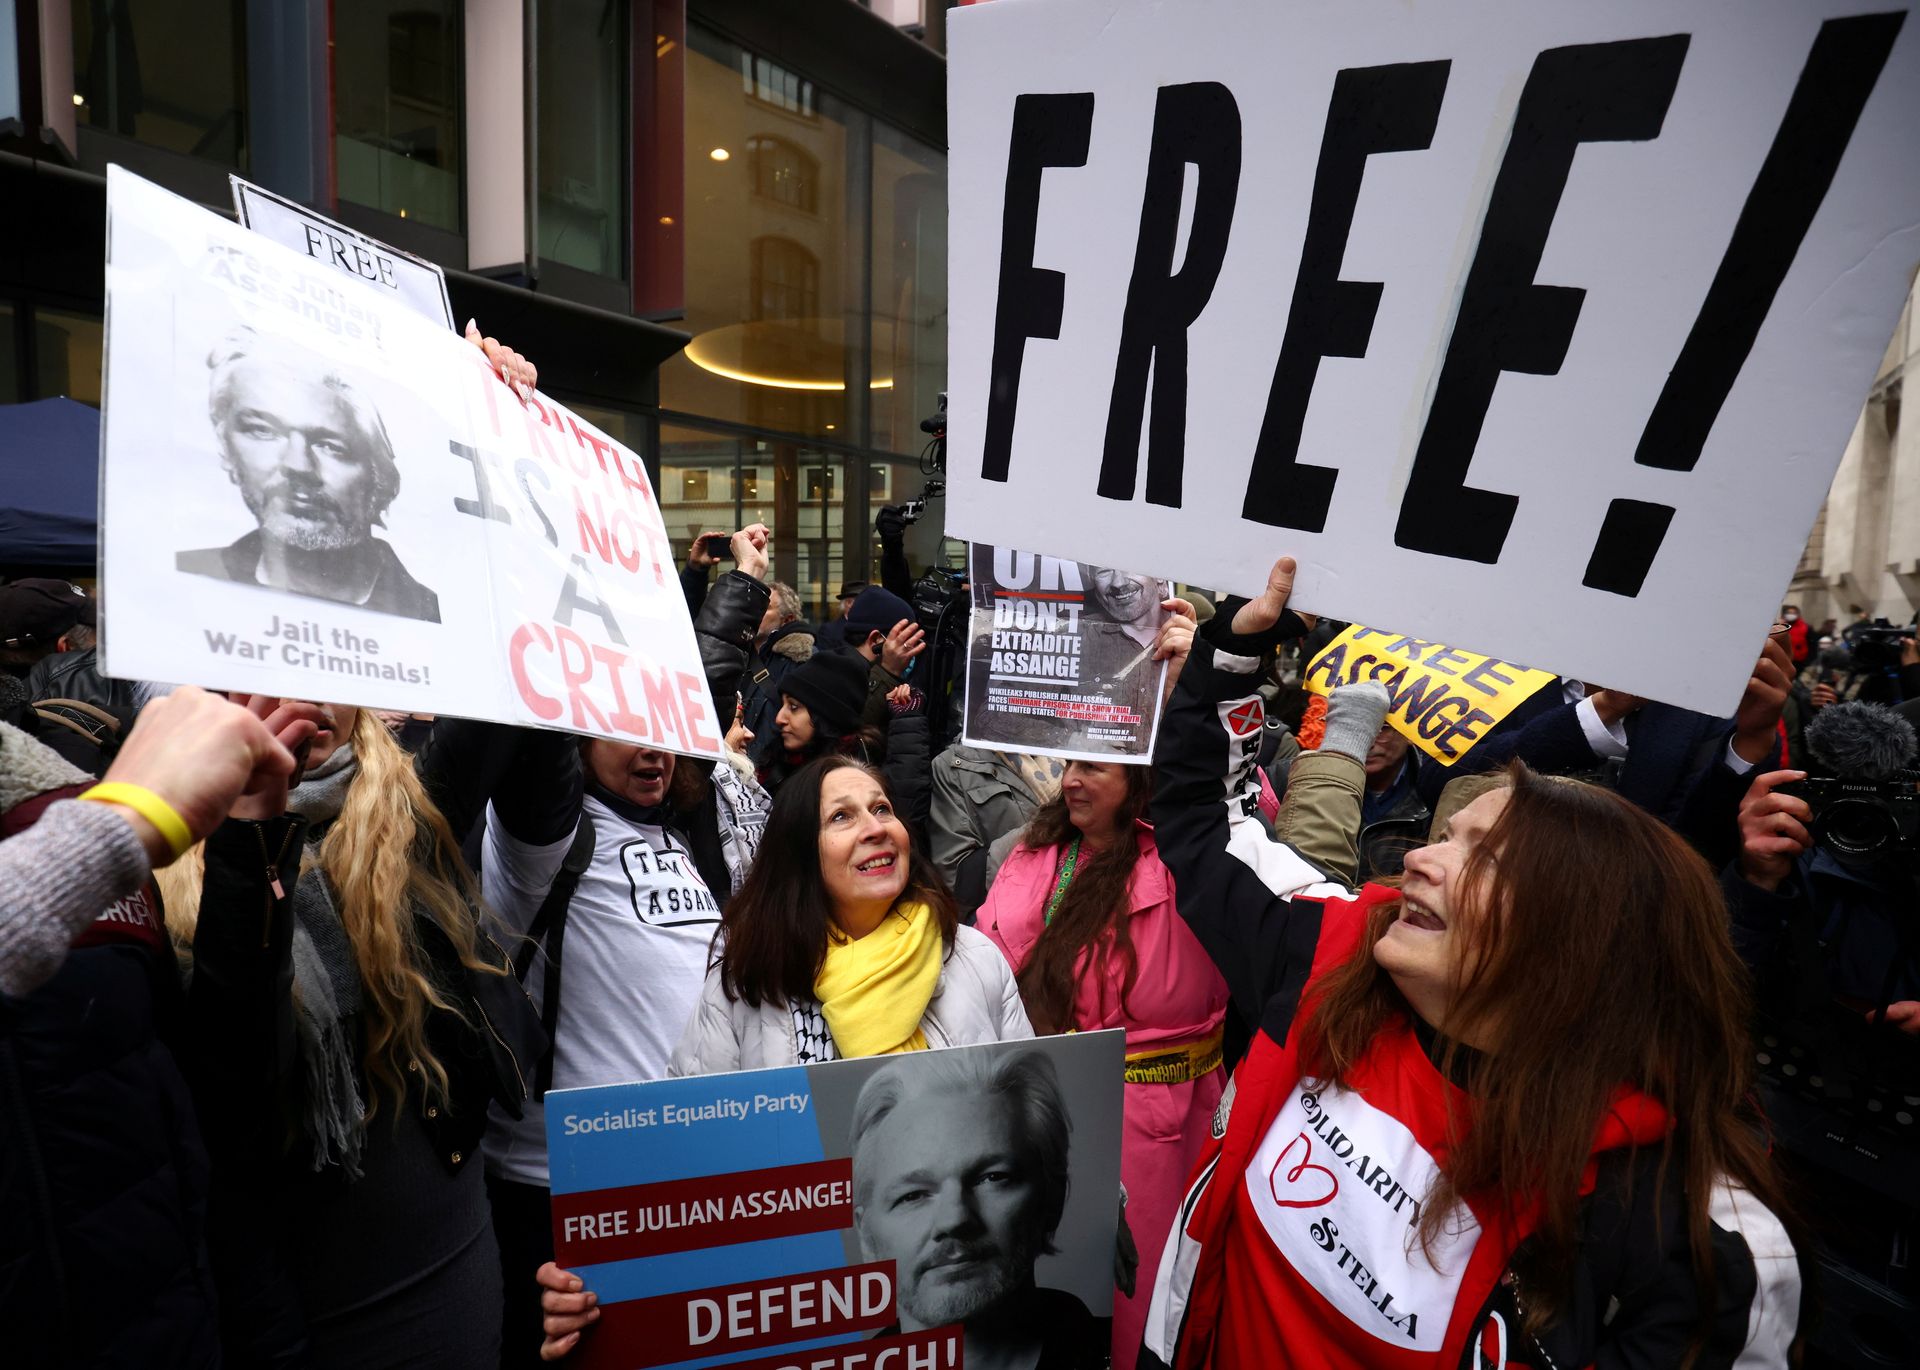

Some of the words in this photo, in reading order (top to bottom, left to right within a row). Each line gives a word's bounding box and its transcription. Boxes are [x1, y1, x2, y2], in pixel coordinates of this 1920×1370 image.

[301, 222, 398, 290] FREE
[980, 10, 1907, 597] FREE!
[449, 440, 559, 549] IS
[575, 484, 668, 587] NOT
[552, 553, 629, 647] A
[993, 598, 1084, 634] DON'T
[263, 615, 323, 646] Jail
[331, 627, 380, 655] the
[991, 631, 1082, 655] EXTRADITE
[203, 629, 271, 662] War
[281, 643, 431, 686] Criminals!
[989, 652, 1081, 678] ASSANGE
[509, 621, 720, 753] CRIME
[988, 687, 1023, 697] WIKILEAKS
[1024, 690, 1059, 701] PUBLISHER
[1060, 693, 1081, 702] JULIAN
[1082, 695, 1112, 705] ASSANGE
[988, 695, 1008, 704] FACES
[1008, 697, 1041, 707] INHUMANE
[1042, 700, 1071, 710] PRISONS
[1091, 705, 1112, 714] SHOW
[1112, 706, 1130, 715] TRIAL
[988, 703, 995, 711] IN
[996, 704, 1008, 712] THE
[1008, 705, 1030, 715] UNITED
[1032, 707, 1055, 717] STATES
[1055, 709, 1069, 719] FOR
[1108, 714, 1120, 723] THE
[1120, 715, 1140, 724] TRUTH
[1842, 784, 1877, 792] FUJIFILM
[648, 887, 720, 915] ASSAN
[563, 1108, 657, 1136] Socialist
[663, 1099, 750, 1126] Equality
[754, 1092, 809, 1114] Party
[563, 1210, 629, 1243] FREE
[636, 1198, 724, 1233] JULIAN
[729, 1180, 852, 1220] ASSANGE!
[1310, 1217, 1419, 1340] STELLA
[687, 1271, 893, 1346] DEFEND
